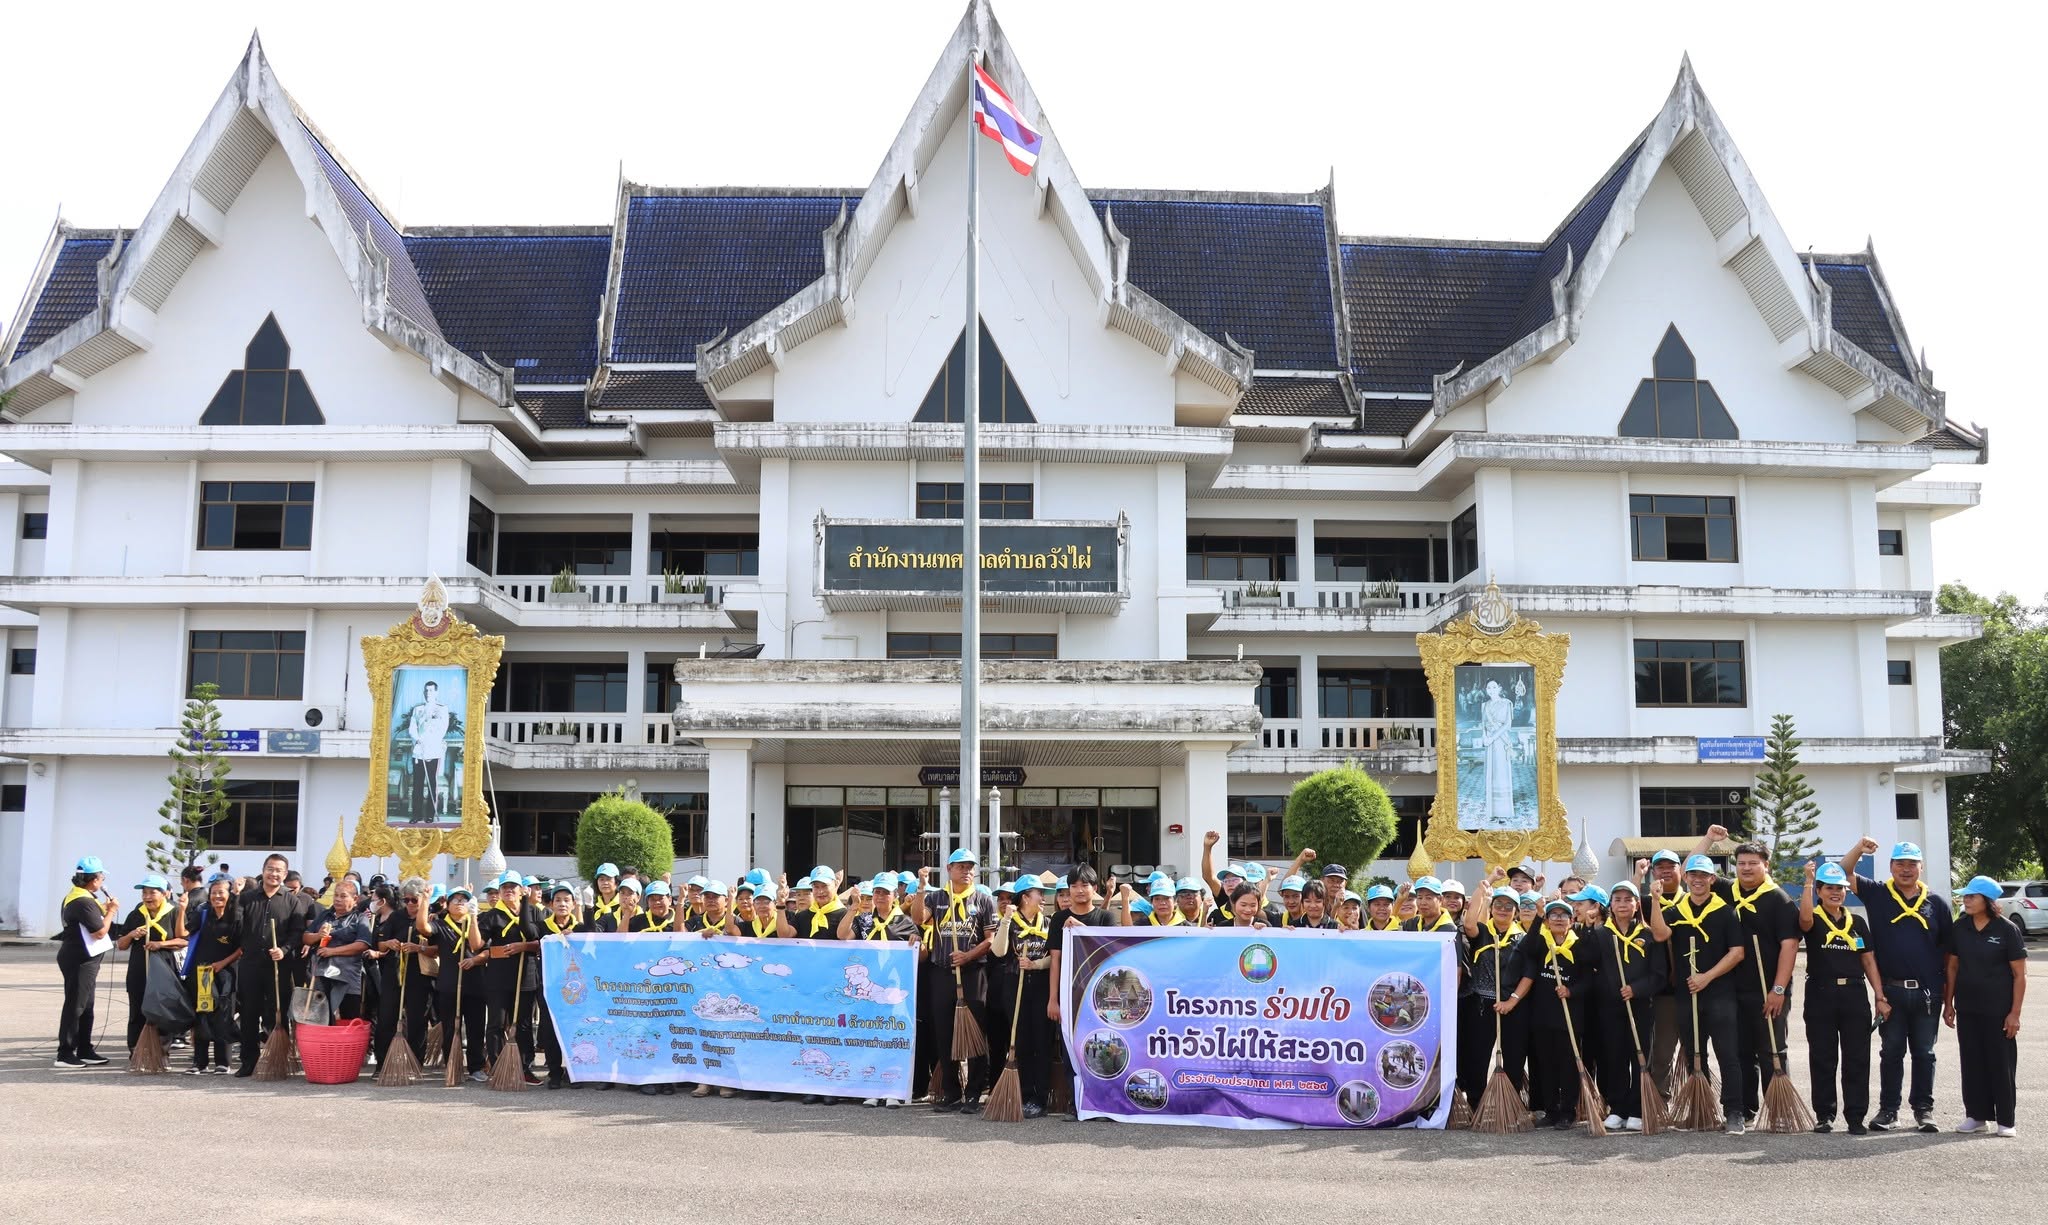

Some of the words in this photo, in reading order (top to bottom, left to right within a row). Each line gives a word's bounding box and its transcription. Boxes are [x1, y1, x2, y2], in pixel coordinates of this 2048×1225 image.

[848, 545, 1092, 569] สำนักงานเทศาลตำบลวังไผ่
[594, 976, 694, 993] โครงการจิตอาสา
[1166, 990, 1258, 1016] โครงการ
[1262, 986, 1351, 1022] ร่วมใจ
[772, 1011, 836, 1027] เราทำความ
[838, 1013, 847, 1028] ดี
[848, 1014, 906, 1031] ด้วยหัวใจ
[671, 1038, 694, 1050] อำเภอ
[1148, 1027, 1365, 1063] ทำวังไผ่ให้สะอาด
[672, 1053, 697, 1065] จังหวัด
[1178, 1073, 1270, 1089] ประจำปีงบประมาณ
[1273, 1080, 1296, 1089] พ.ศ.
